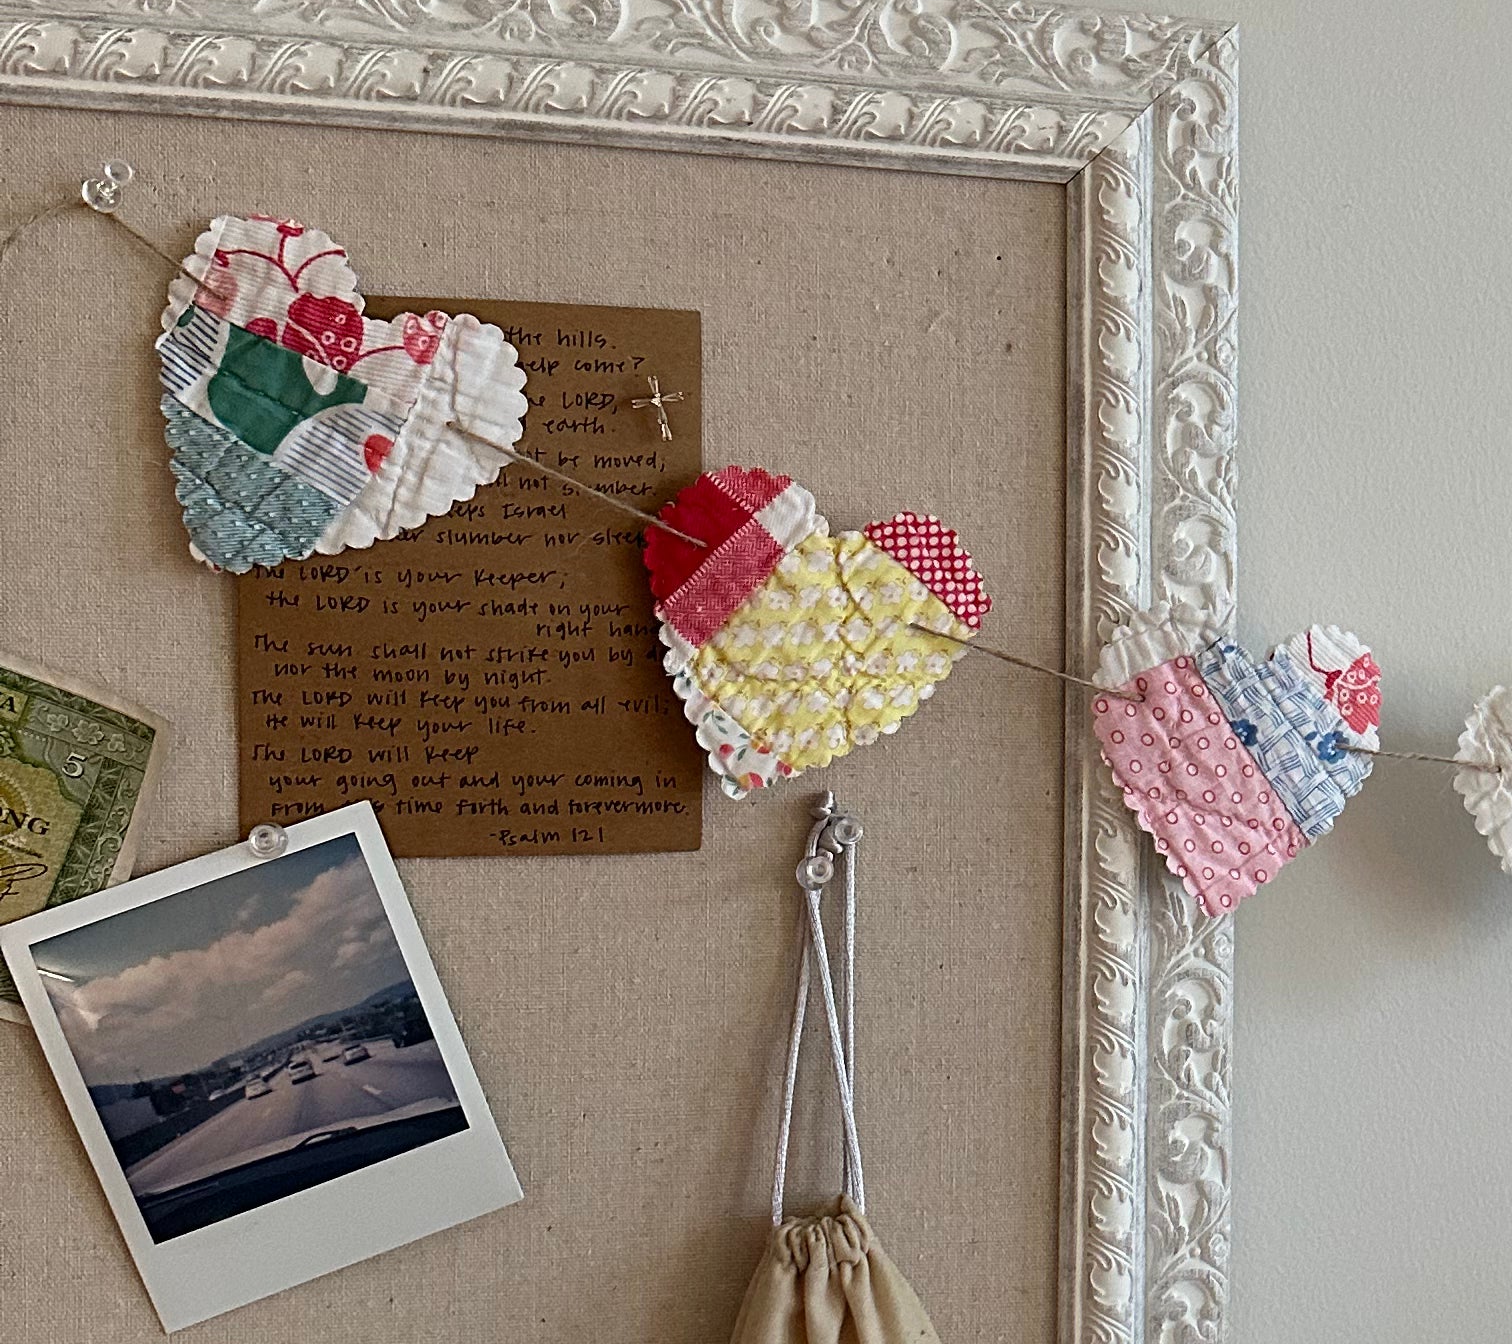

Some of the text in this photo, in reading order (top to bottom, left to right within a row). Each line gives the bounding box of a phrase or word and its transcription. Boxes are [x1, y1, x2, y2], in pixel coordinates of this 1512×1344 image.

[506, 326, 616, 349] the hills.
[574, 356, 645, 377] come?
[563, 392, 618, 415] LORD,
[558, 451, 579, 468] be
[594, 451, 665, 472] moved;
[519, 475, 549, 491] not
[502, 503, 566, 519] Israel
[436, 529, 532, 546] slumber
[544, 533, 580, 547] nor
[365, 567, 382, 584] is
[398, 569, 462, 588] your
[266, 590, 299, 607] the
[383, 600, 398, 614] is
[413, 600, 471, 622] your
[477, 598, 538, 616] shade
[549, 603, 570, 616] on
[580, 604, 630, 625] your
[537, 621, 593, 640] right
[255, 633, 288, 652] The
[308, 642, 352, 657] sun
[371, 642, 426, 660] shall
[440, 645, 477, 662] not
[559, 651, 594, 669] you
[609, 647, 633, 666] by
[275, 664, 312, 677] nor
[322, 662, 357, 680] the
[373, 669, 429, 683] moon
[445, 670, 469, 691] by
[252, 689, 282, 706] The
[368, 689, 406, 707] will
[474, 696, 510, 714] you
[518, 696, 570, 714] from
[581, 696, 605, 715] all
[266, 713, 288, 730] He
[301, 712, 337, 730] will
[418, 720, 472, 743] your
[489, 716, 536, 736] life.
[252, 742, 285, 761] The
[368, 745, 409, 763] will
[62, 751, 87, 778] 5
[270, 770, 676, 797] your going out and your coming in
[395, 796, 442, 814] time
[456, 798, 509, 816] forth
[520, 799, 559, 815] and
[572, 827, 603, 842] 121
